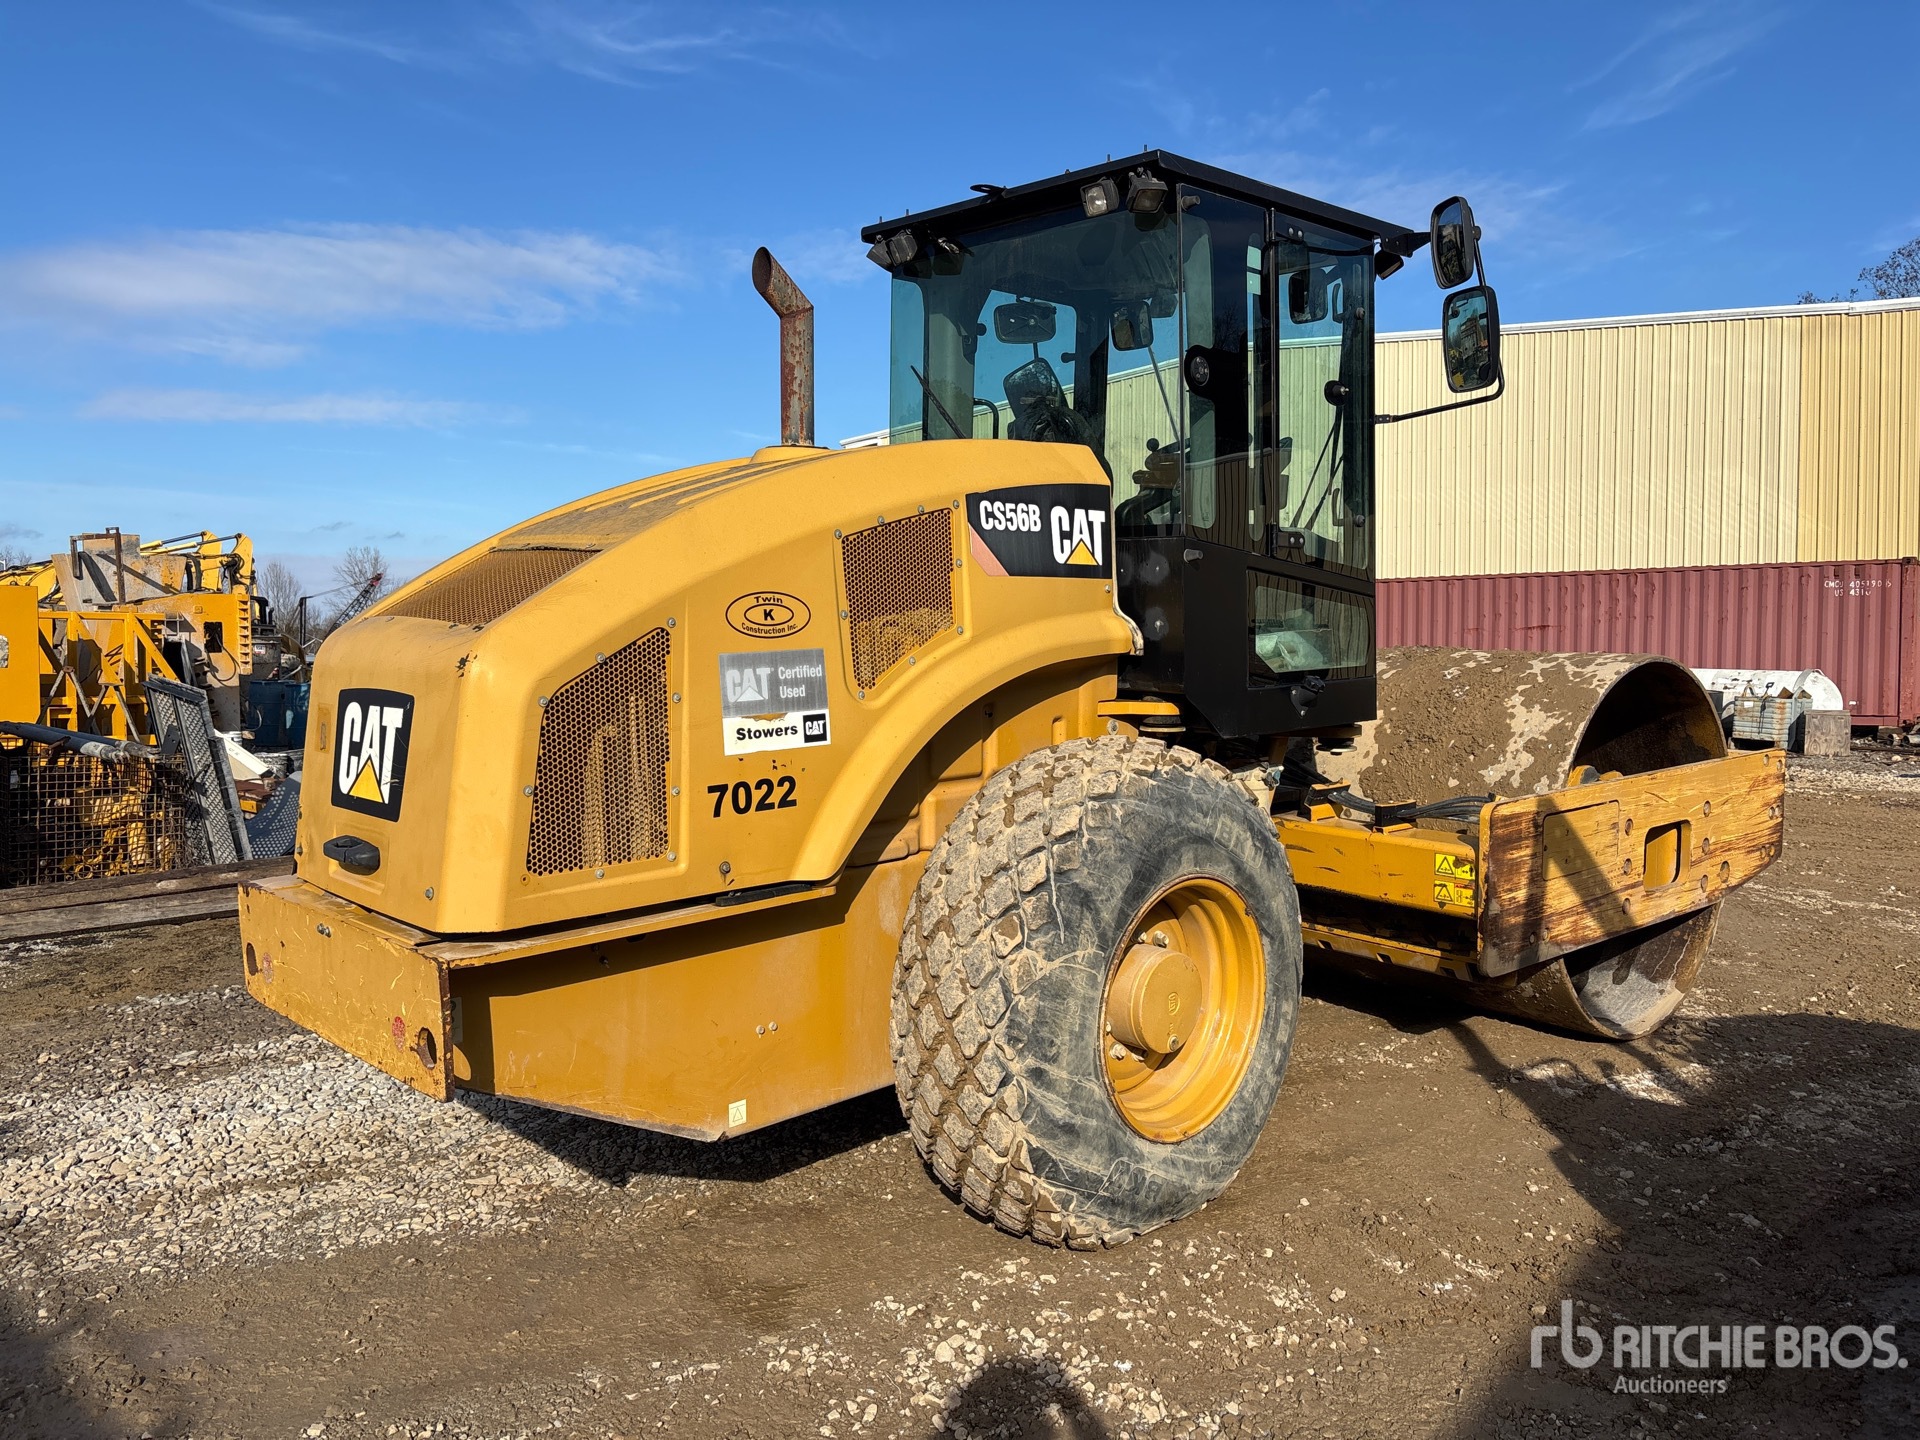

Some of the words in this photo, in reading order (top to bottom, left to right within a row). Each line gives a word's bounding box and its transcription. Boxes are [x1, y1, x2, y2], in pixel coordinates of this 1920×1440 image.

[979, 500, 1041, 532] CS56B
[1050, 506, 1105, 566] CAT
[754, 595, 783, 604] Twin
[1834, 589, 1844, 597] US
[763, 609, 775, 621] K
[741, 622, 786, 635] Construction
[787, 624, 798, 632] Inc.
[726, 667, 771, 702] CAT
[778, 664, 822, 680] Certified
[779, 684, 806, 699] Used
[736, 725, 798, 741] Stowers
[805, 720, 825, 735] CAT
[338, 701, 404, 804] CAT
[707, 775, 798, 818] 7022
